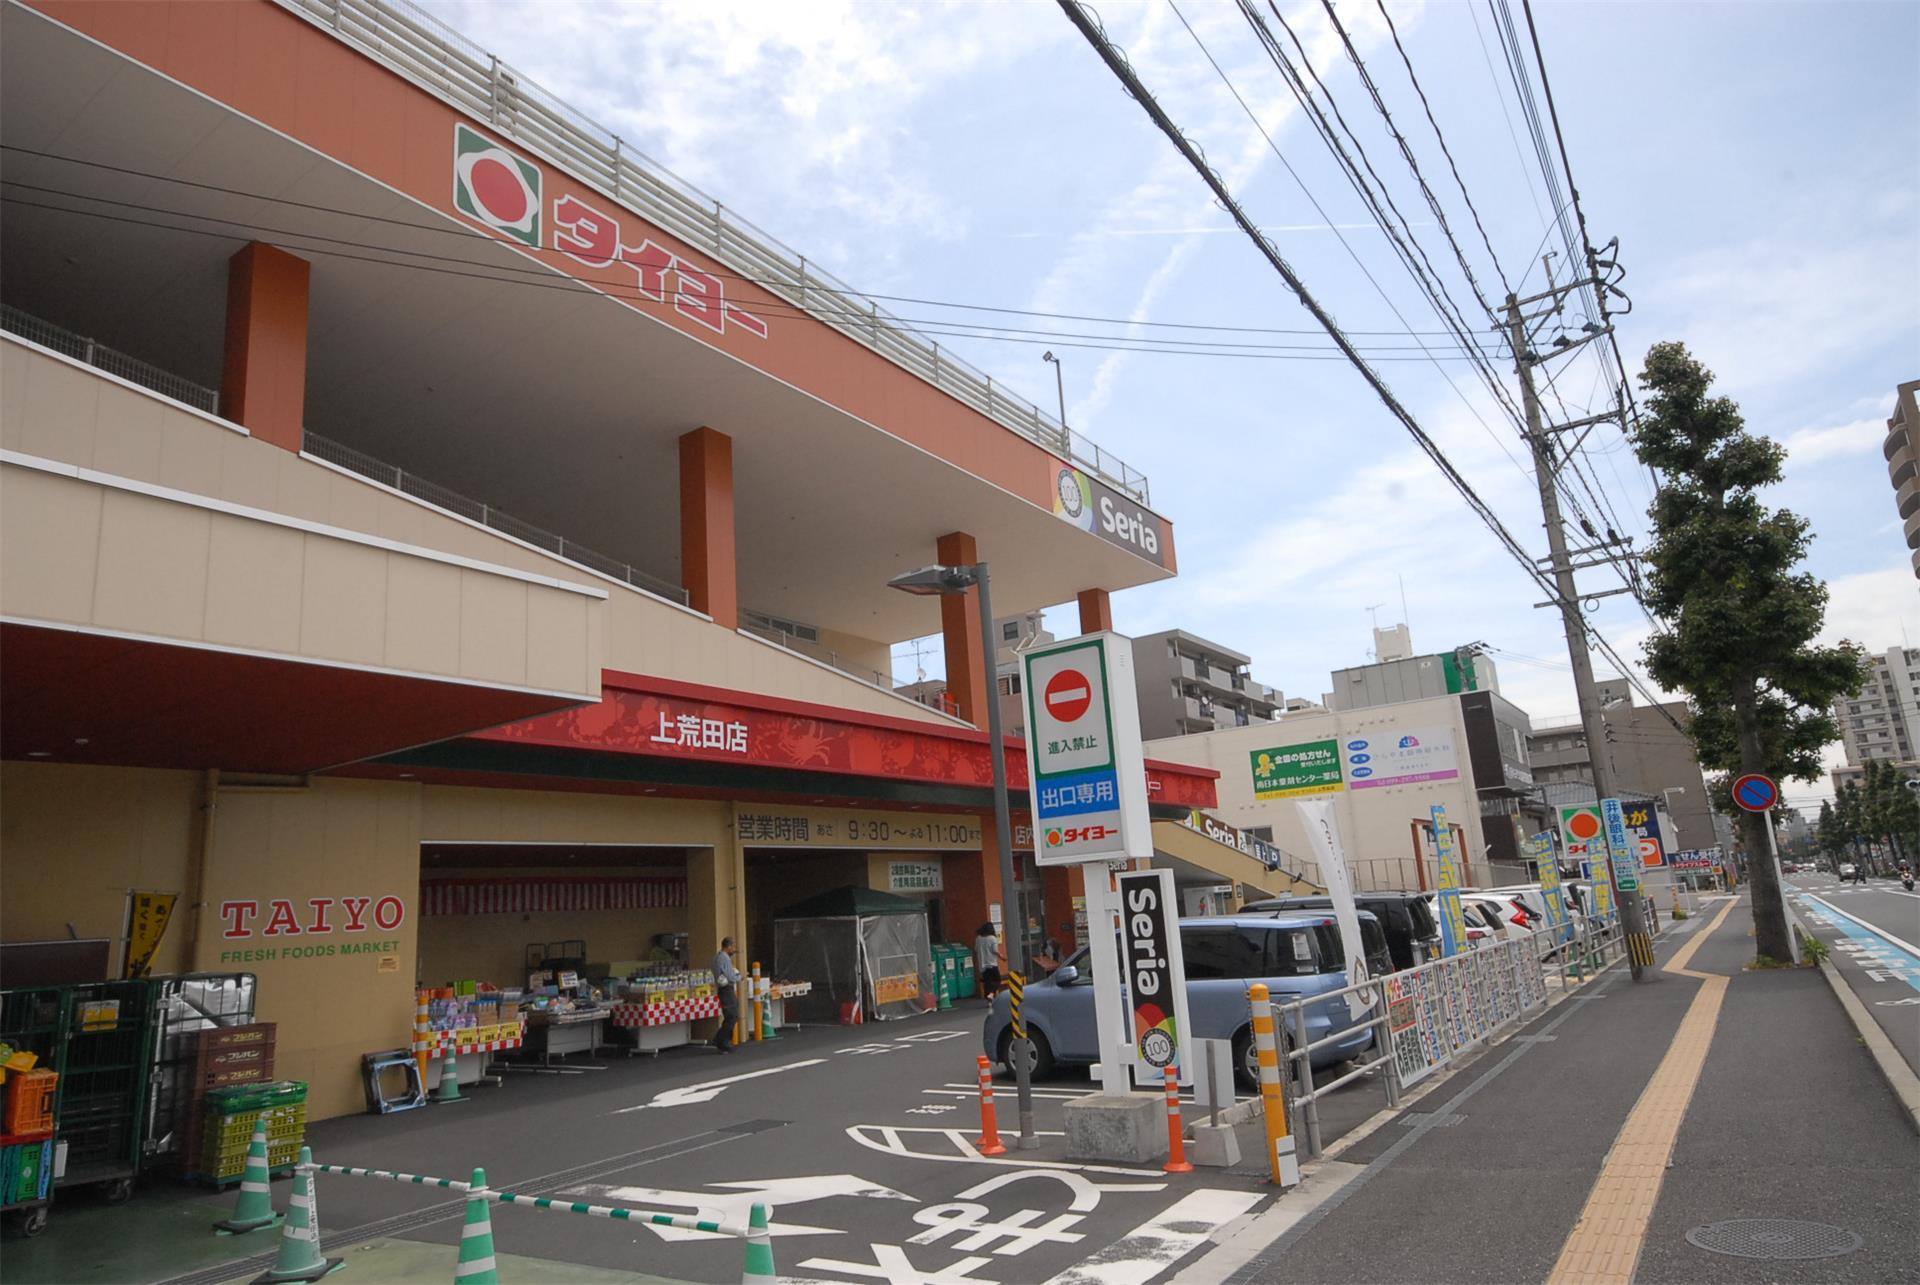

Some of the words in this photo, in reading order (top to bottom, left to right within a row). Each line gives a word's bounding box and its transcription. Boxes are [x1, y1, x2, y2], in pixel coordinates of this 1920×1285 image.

[554, 193, 768, 339] タイヨー
[1100, 496, 1158, 554] Seria
[650, 711, 748, 753] 上荒田店
[1047, 735, 1098, 755] 進入禁止
[1041, 780, 1114, 809] 出口専用
[738, 814, 809, 842] 営業時間
[816, 824, 834, 837] あさ
[848, 820, 890, 841] 9:30
[1064, 825, 1118, 844] タイヨー
[1205, 819, 1236, 848] Seria
[1606, 801, 1625, 846] 井後眼科
[220, 895, 405, 938] TAIYO
[221, 951, 276, 963] FRESH
[281, 945, 336, 960] FOODS
[340, 940, 400, 956] MARKET
[1128, 887, 1166, 996] Seria
[1147, 1039, 1169, 1056] 100
